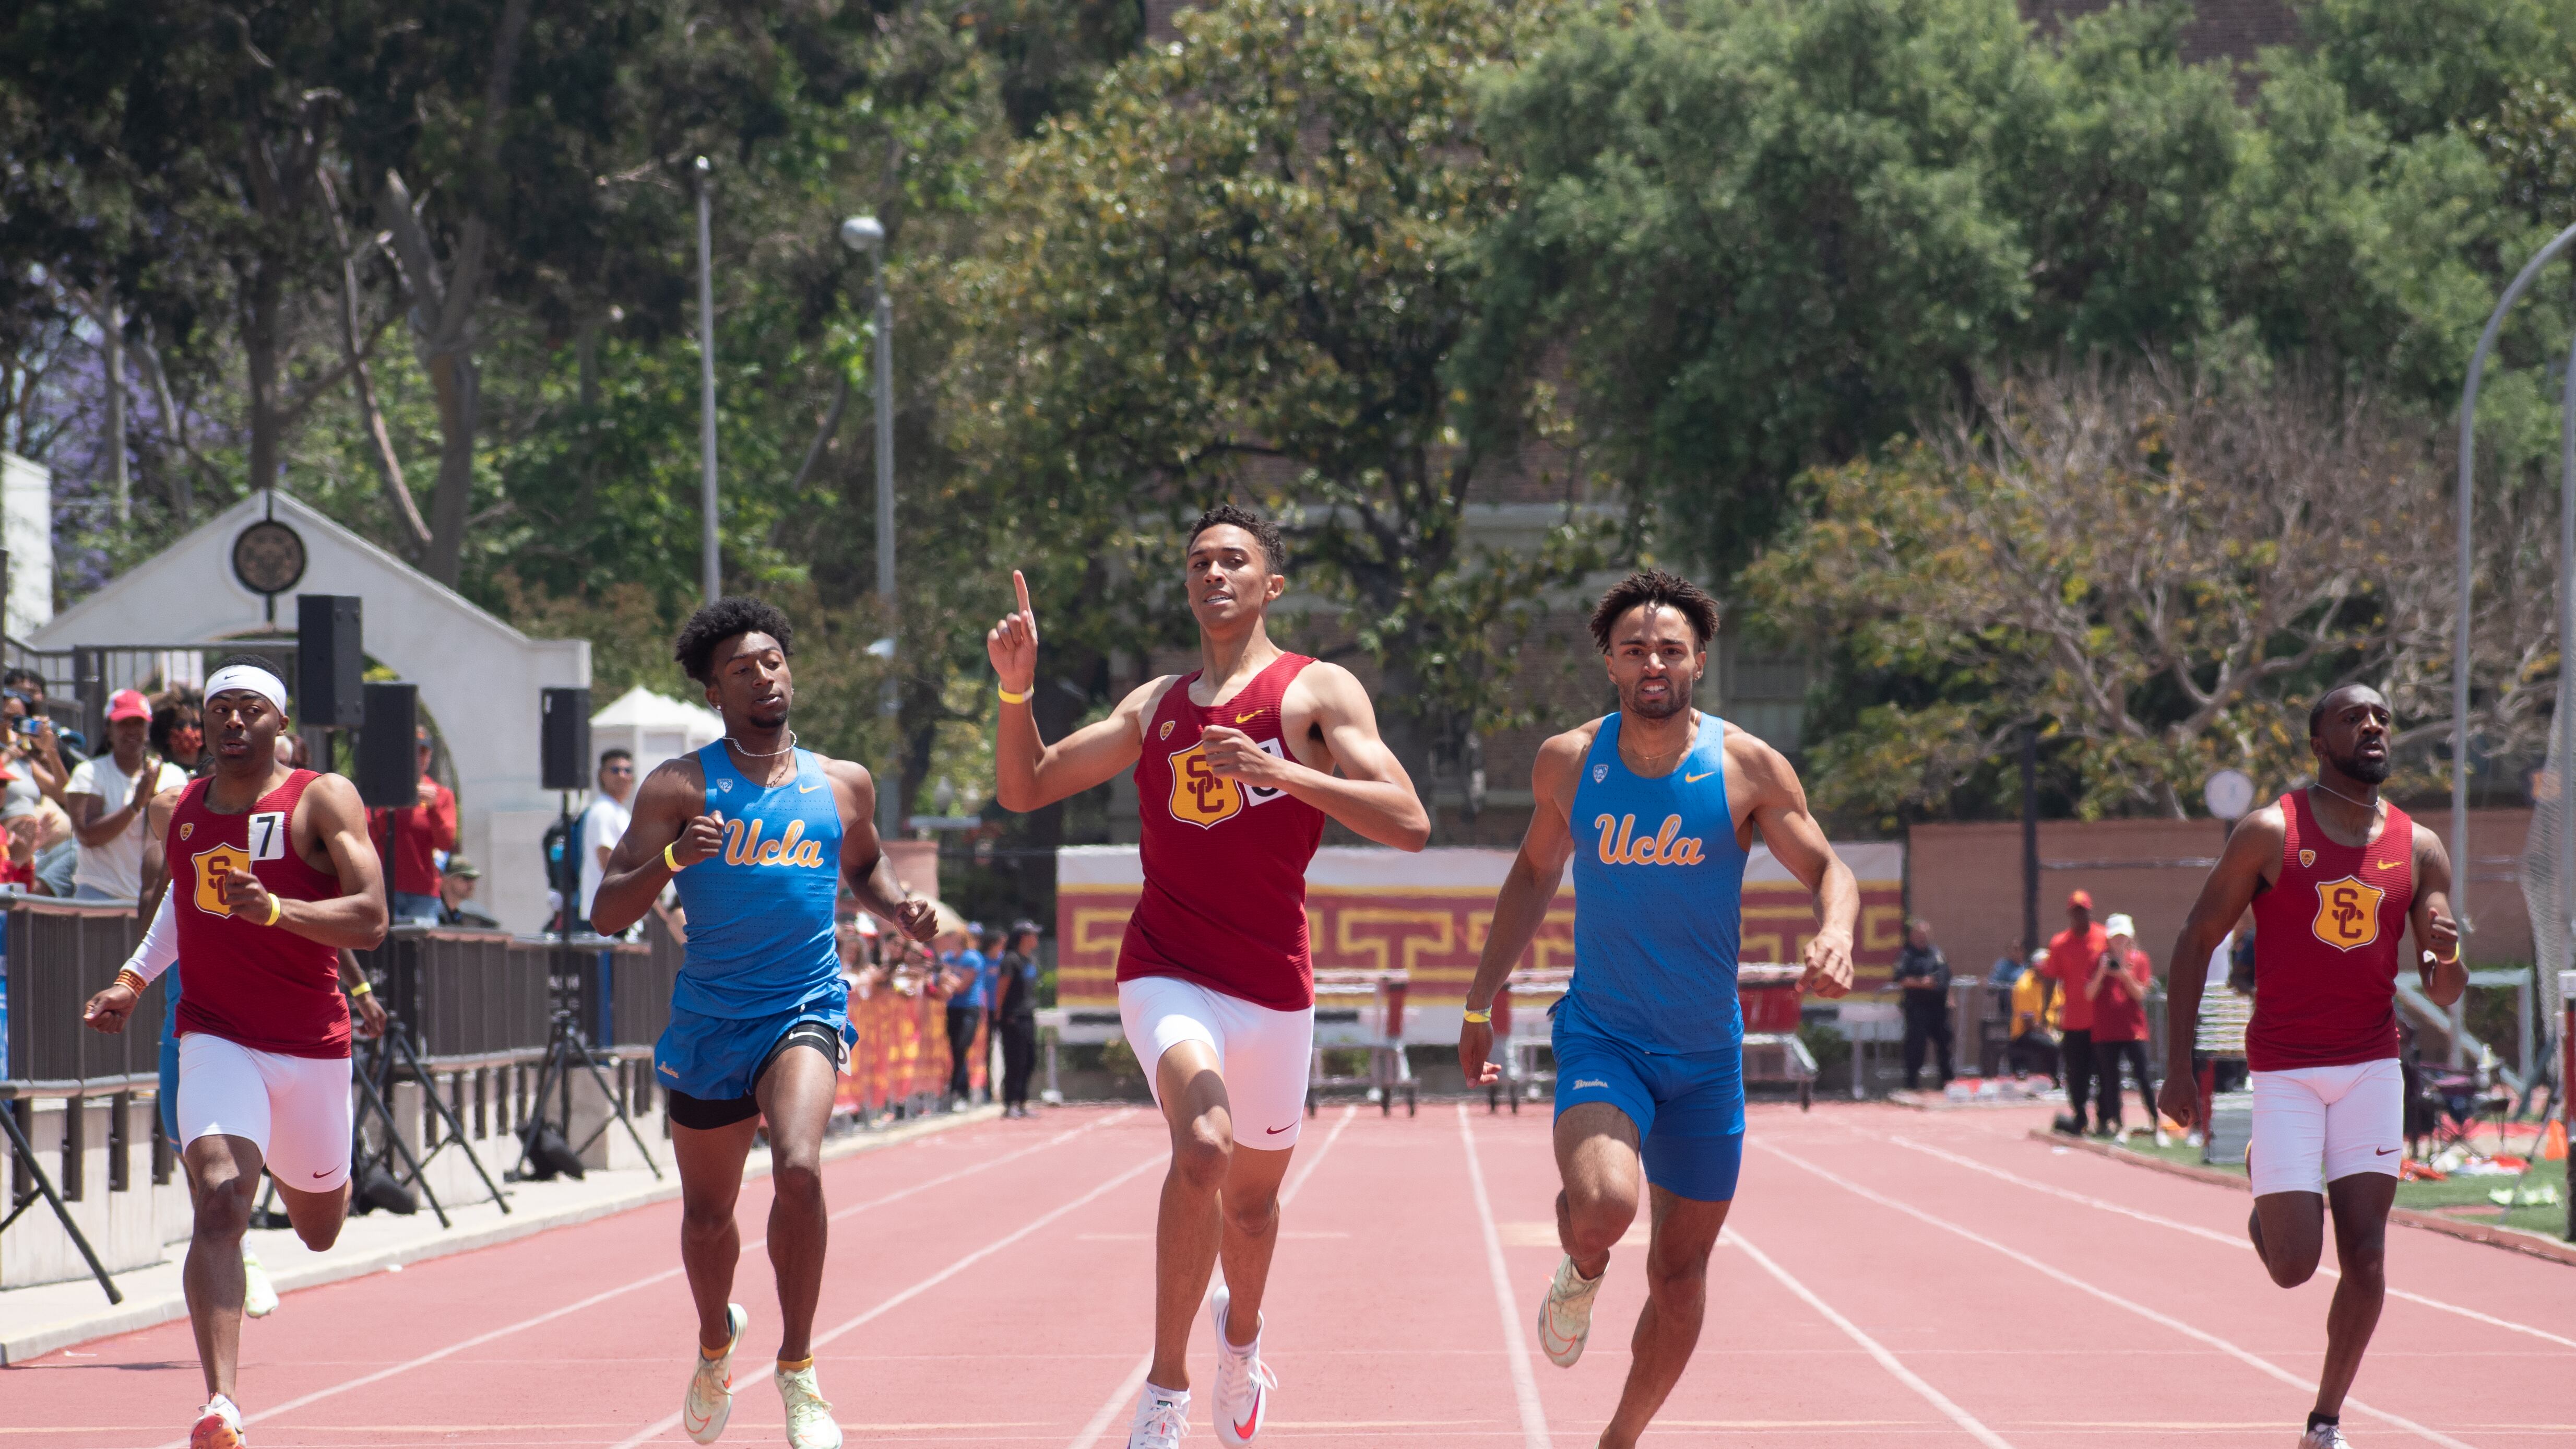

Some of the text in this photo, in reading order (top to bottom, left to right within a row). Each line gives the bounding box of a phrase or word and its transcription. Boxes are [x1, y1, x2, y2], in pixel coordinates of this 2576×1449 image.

[1186, 755, 1225, 814] SC
[257, 816, 276, 857] 7
[725, 818, 824, 868] Ucla
[1595, 814, 1705, 866] Ucla
[2332, 888, 2364, 939] SC
